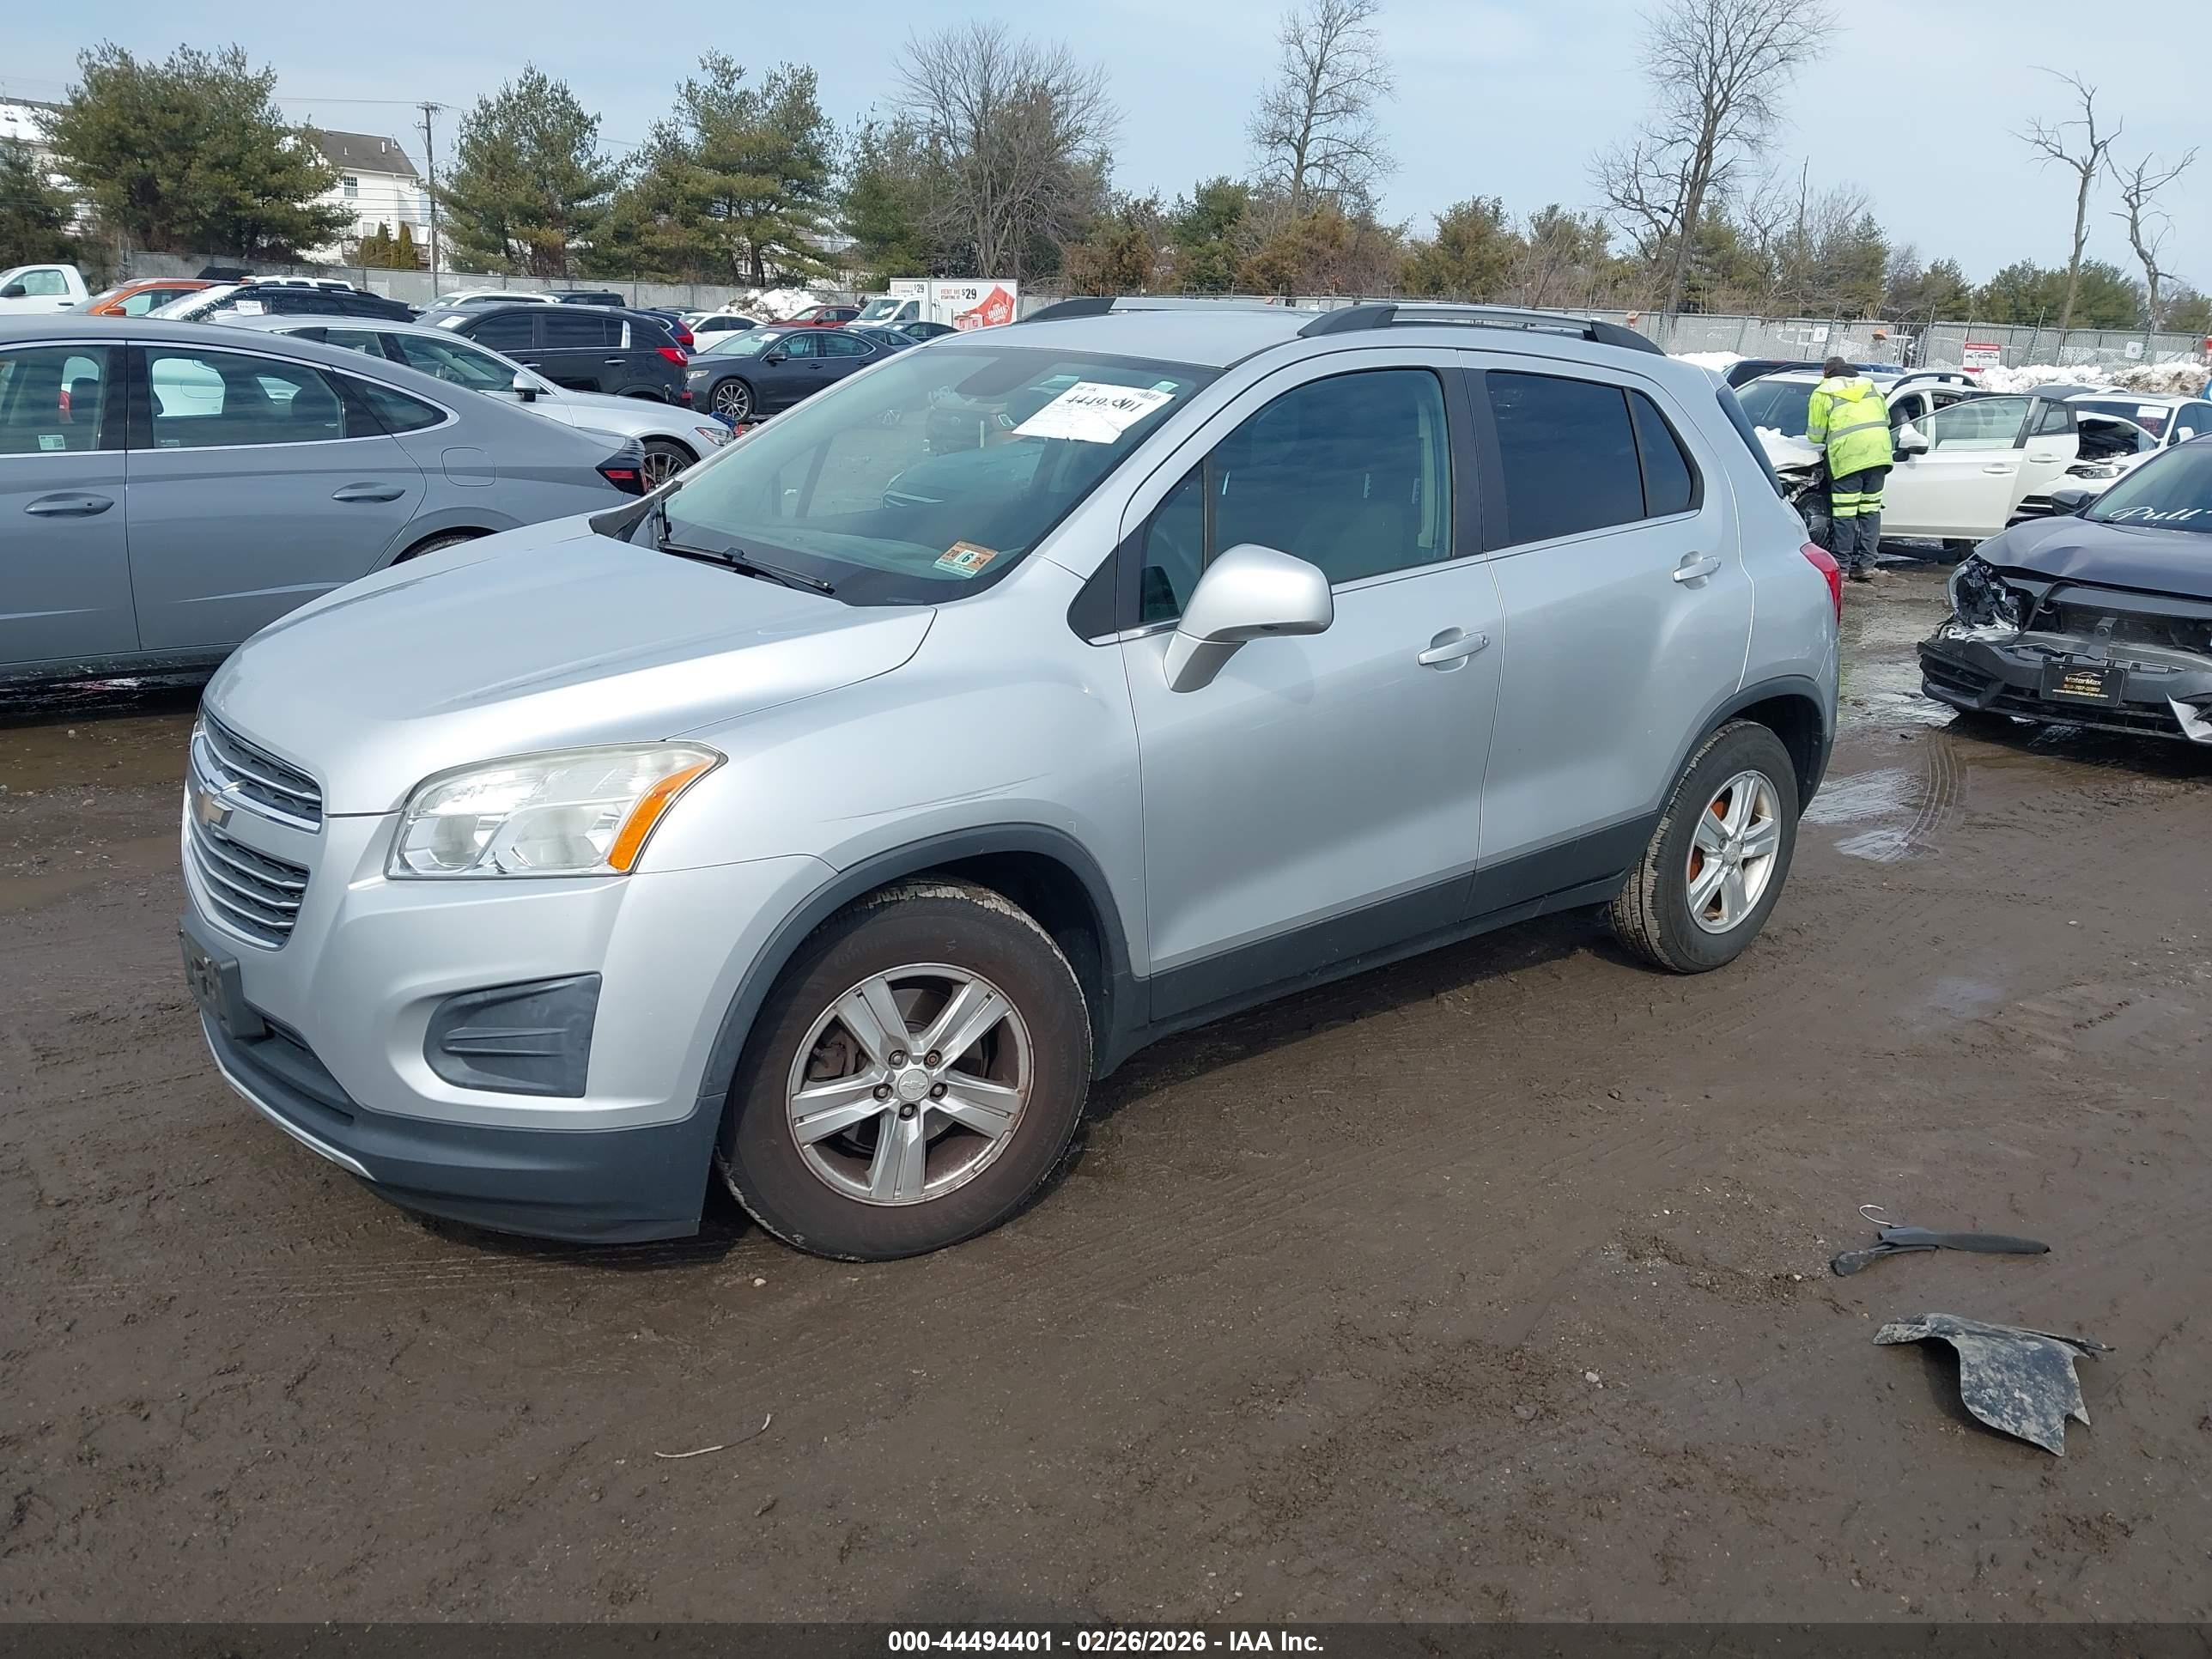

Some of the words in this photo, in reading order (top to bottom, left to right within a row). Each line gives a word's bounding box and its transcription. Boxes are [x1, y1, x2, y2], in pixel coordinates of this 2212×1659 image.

[914, 283, 925, 293] $29
[962, 288, 977, 300] $29
[2109, 506, 2203, 521] Pull
[961, 553, 974, 563] 6
[2064, 676, 2102, 686] MotorMax
